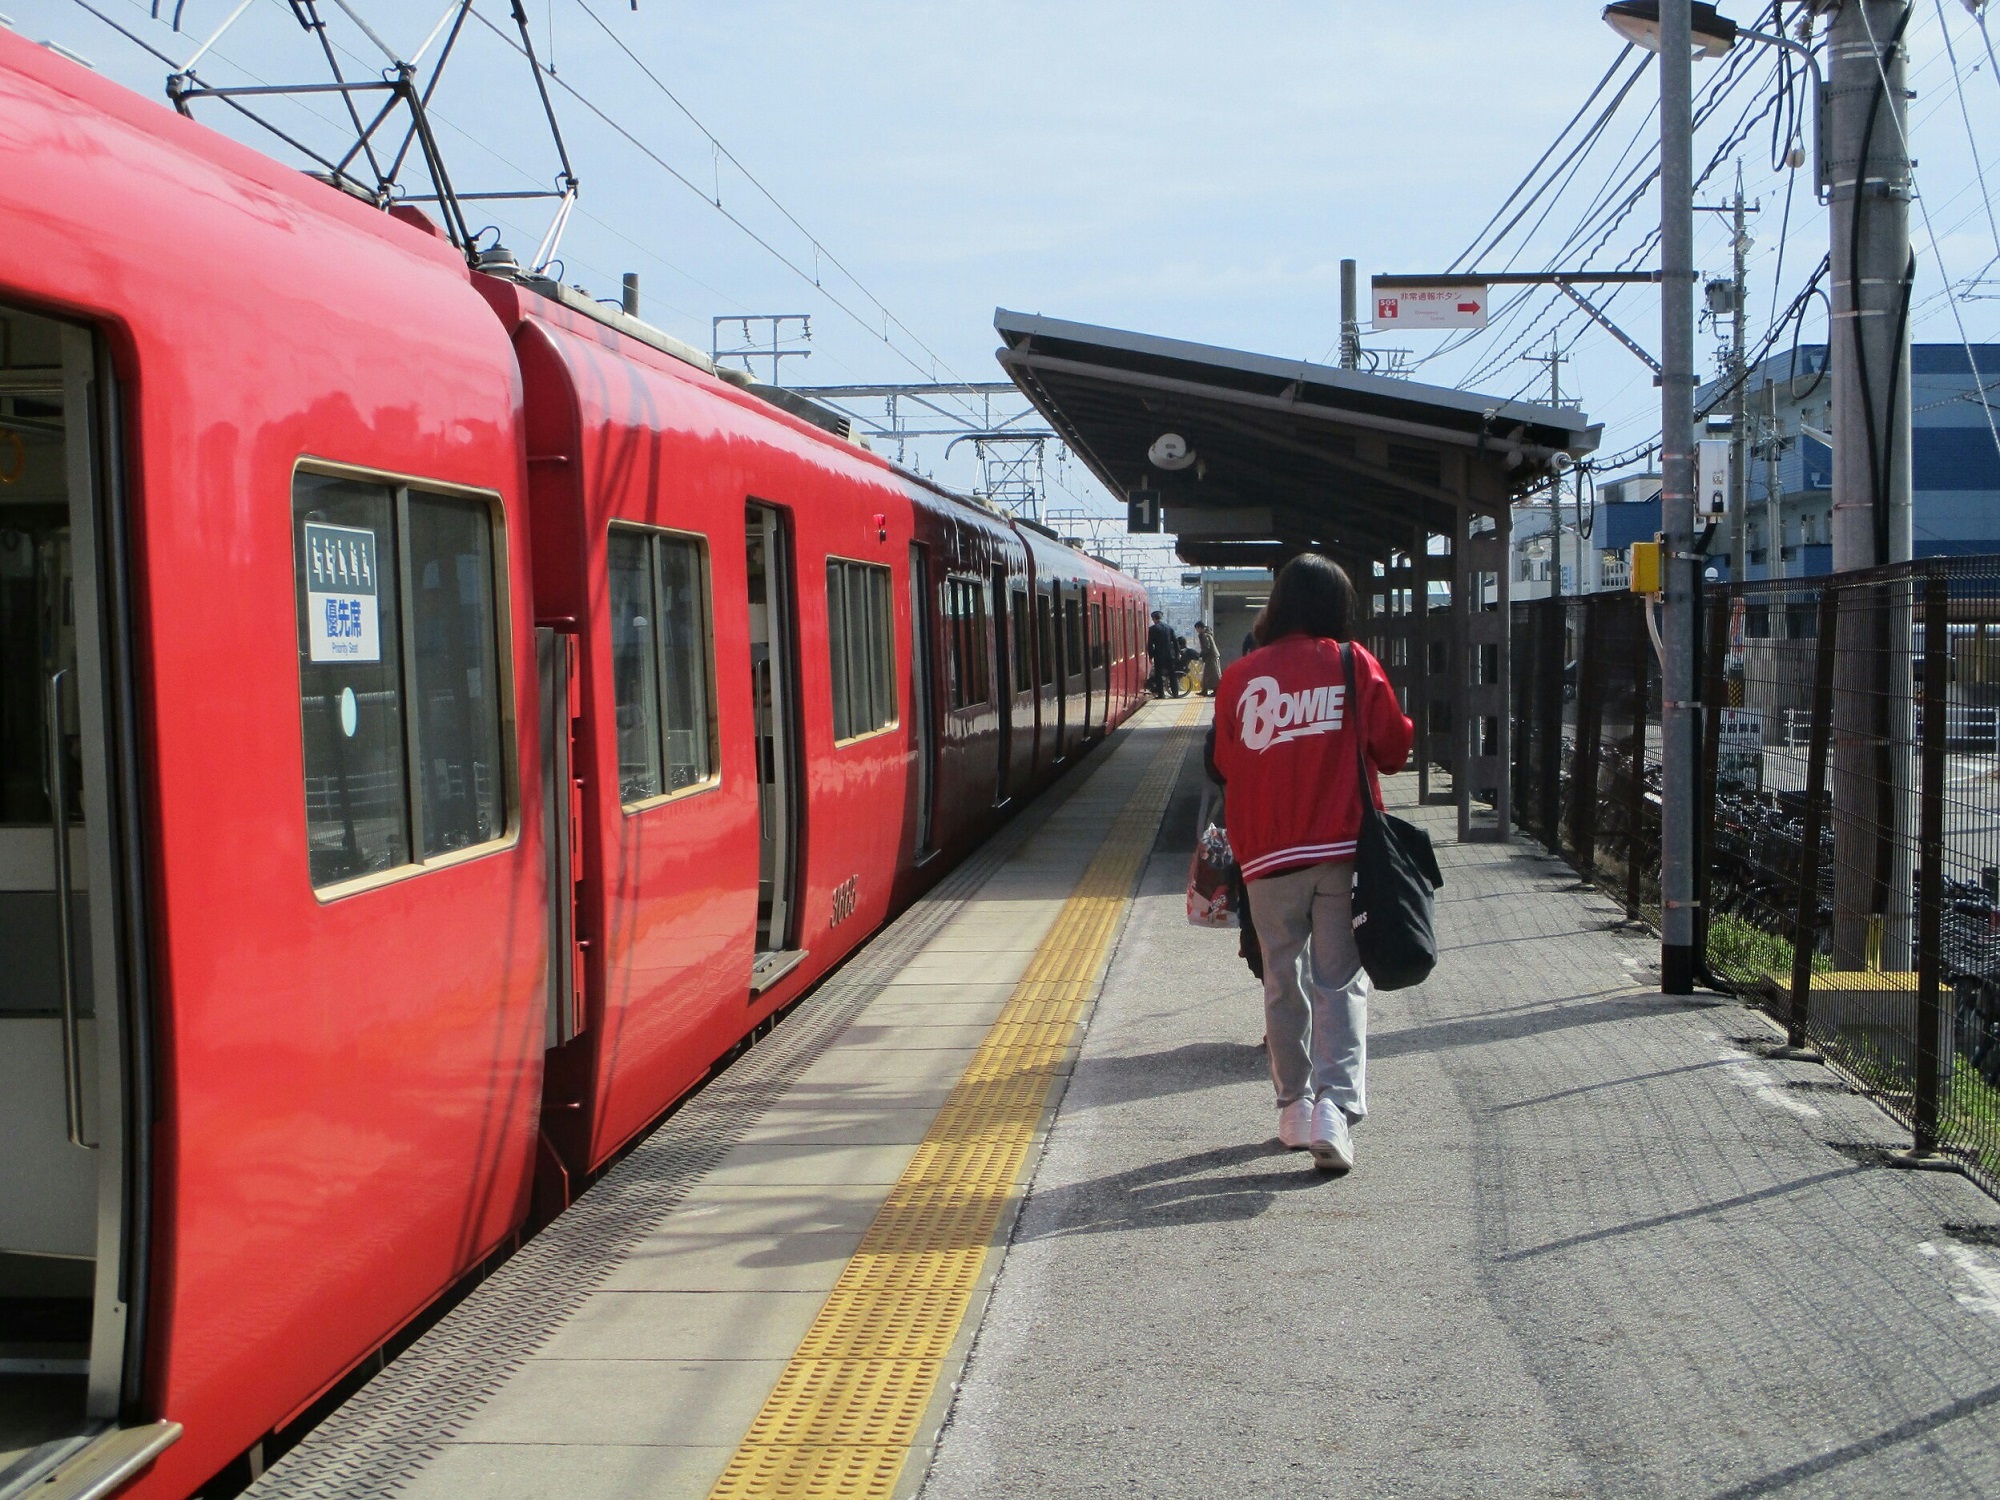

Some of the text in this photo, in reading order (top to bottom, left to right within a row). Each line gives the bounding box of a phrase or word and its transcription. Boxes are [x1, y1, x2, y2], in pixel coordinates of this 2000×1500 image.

[1135, 499, 1151, 524] 1
[325, 598, 362, 638] 優先席
